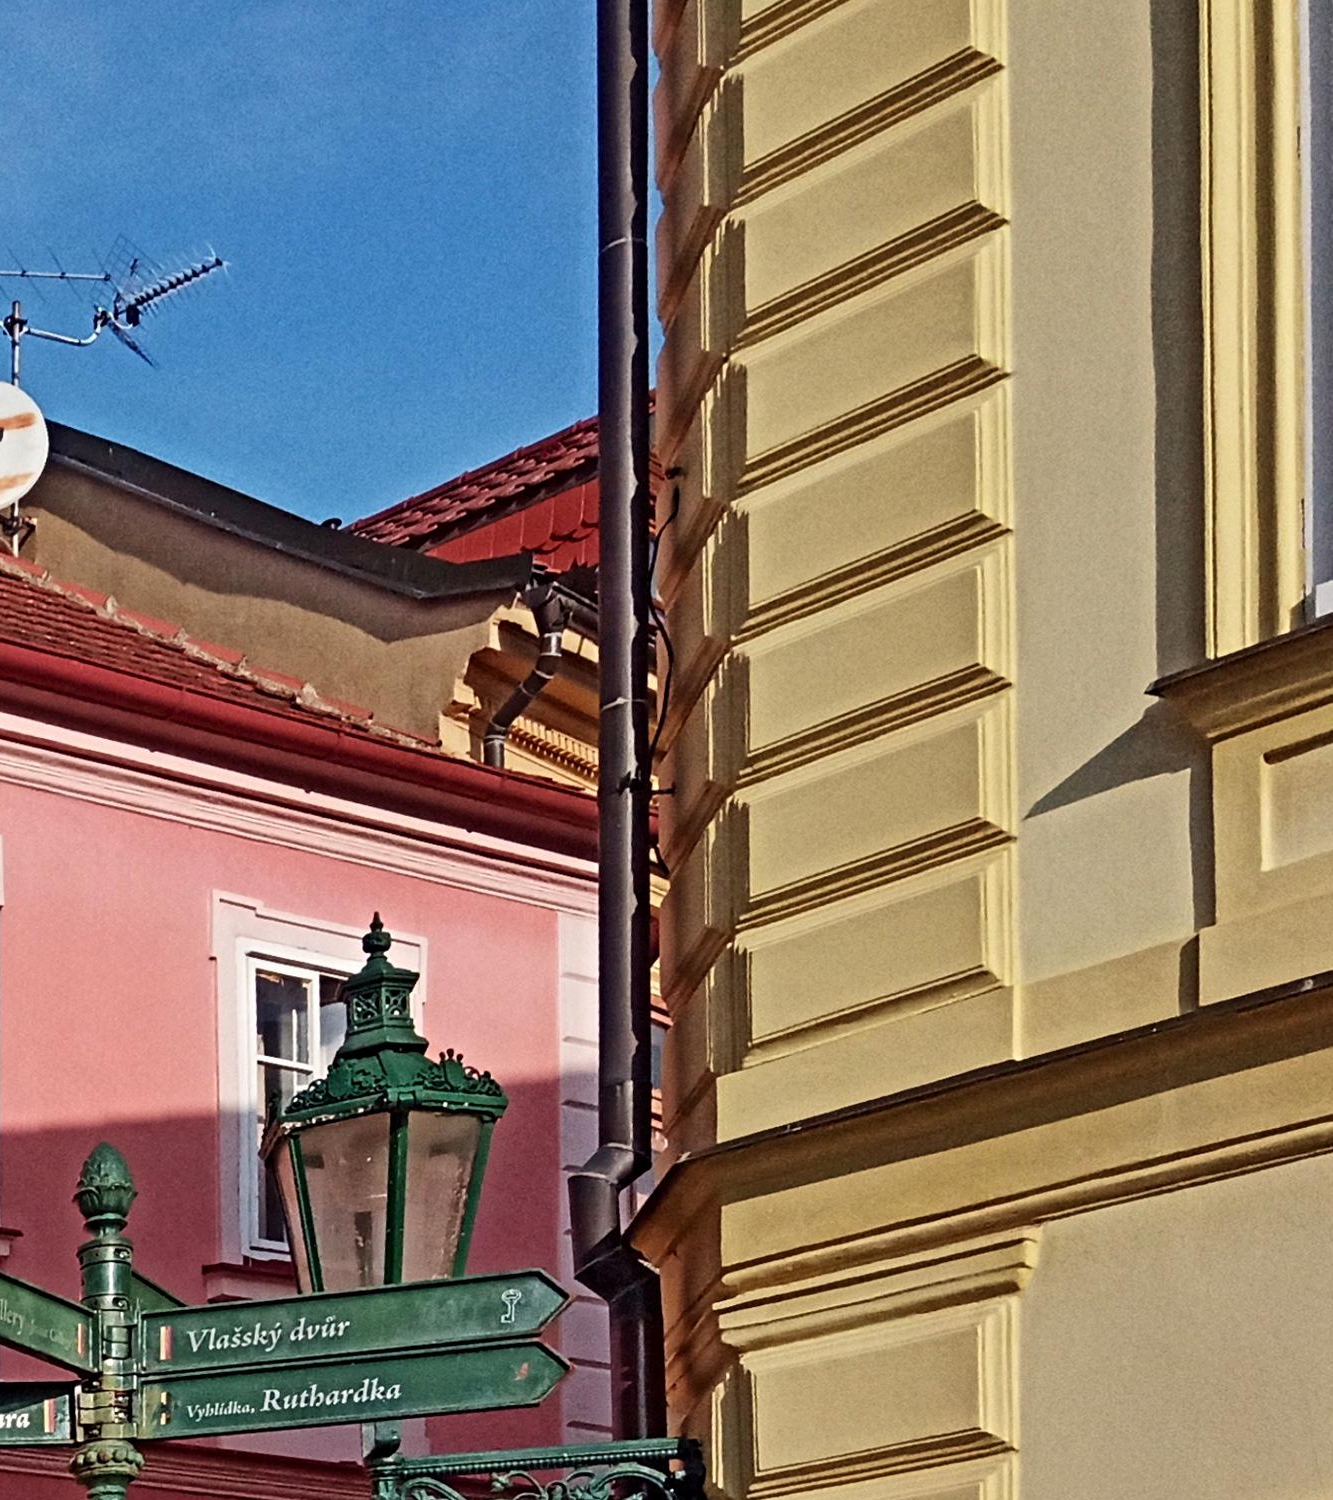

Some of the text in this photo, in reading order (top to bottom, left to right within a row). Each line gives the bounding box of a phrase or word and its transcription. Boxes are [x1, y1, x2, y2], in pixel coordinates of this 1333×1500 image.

[187, 1315, 350, 1352] Vlašský dvůr
[260, 1378, 403, 1412] Ruthardka
